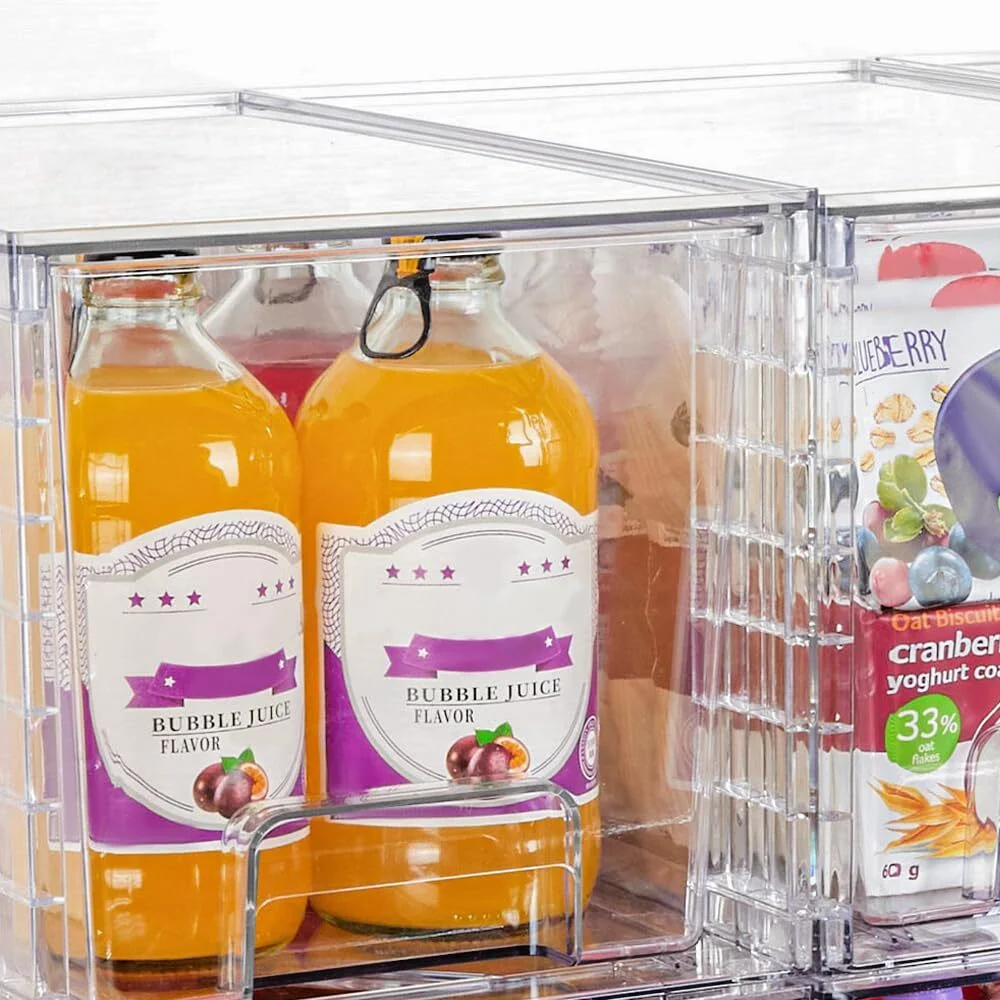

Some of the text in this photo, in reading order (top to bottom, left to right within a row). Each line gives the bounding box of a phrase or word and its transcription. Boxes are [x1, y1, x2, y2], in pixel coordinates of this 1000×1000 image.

[853, 328, 948, 375] LUEBERRY
[891, 612, 931, 632] Oat
[406, 677, 561, 704] BUBBLE JUICE
[886, 663, 970, 695] yoghurt
[152, 700, 291, 733] BUBBLE JUICE
[414, 708, 475, 724] FLAVOR
[896, 706, 958, 742] 33%
[161, 735, 221, 754] FLAVOR
[917, 741, 936, 753] oat
[882, 863, 919, 880] 60 g
